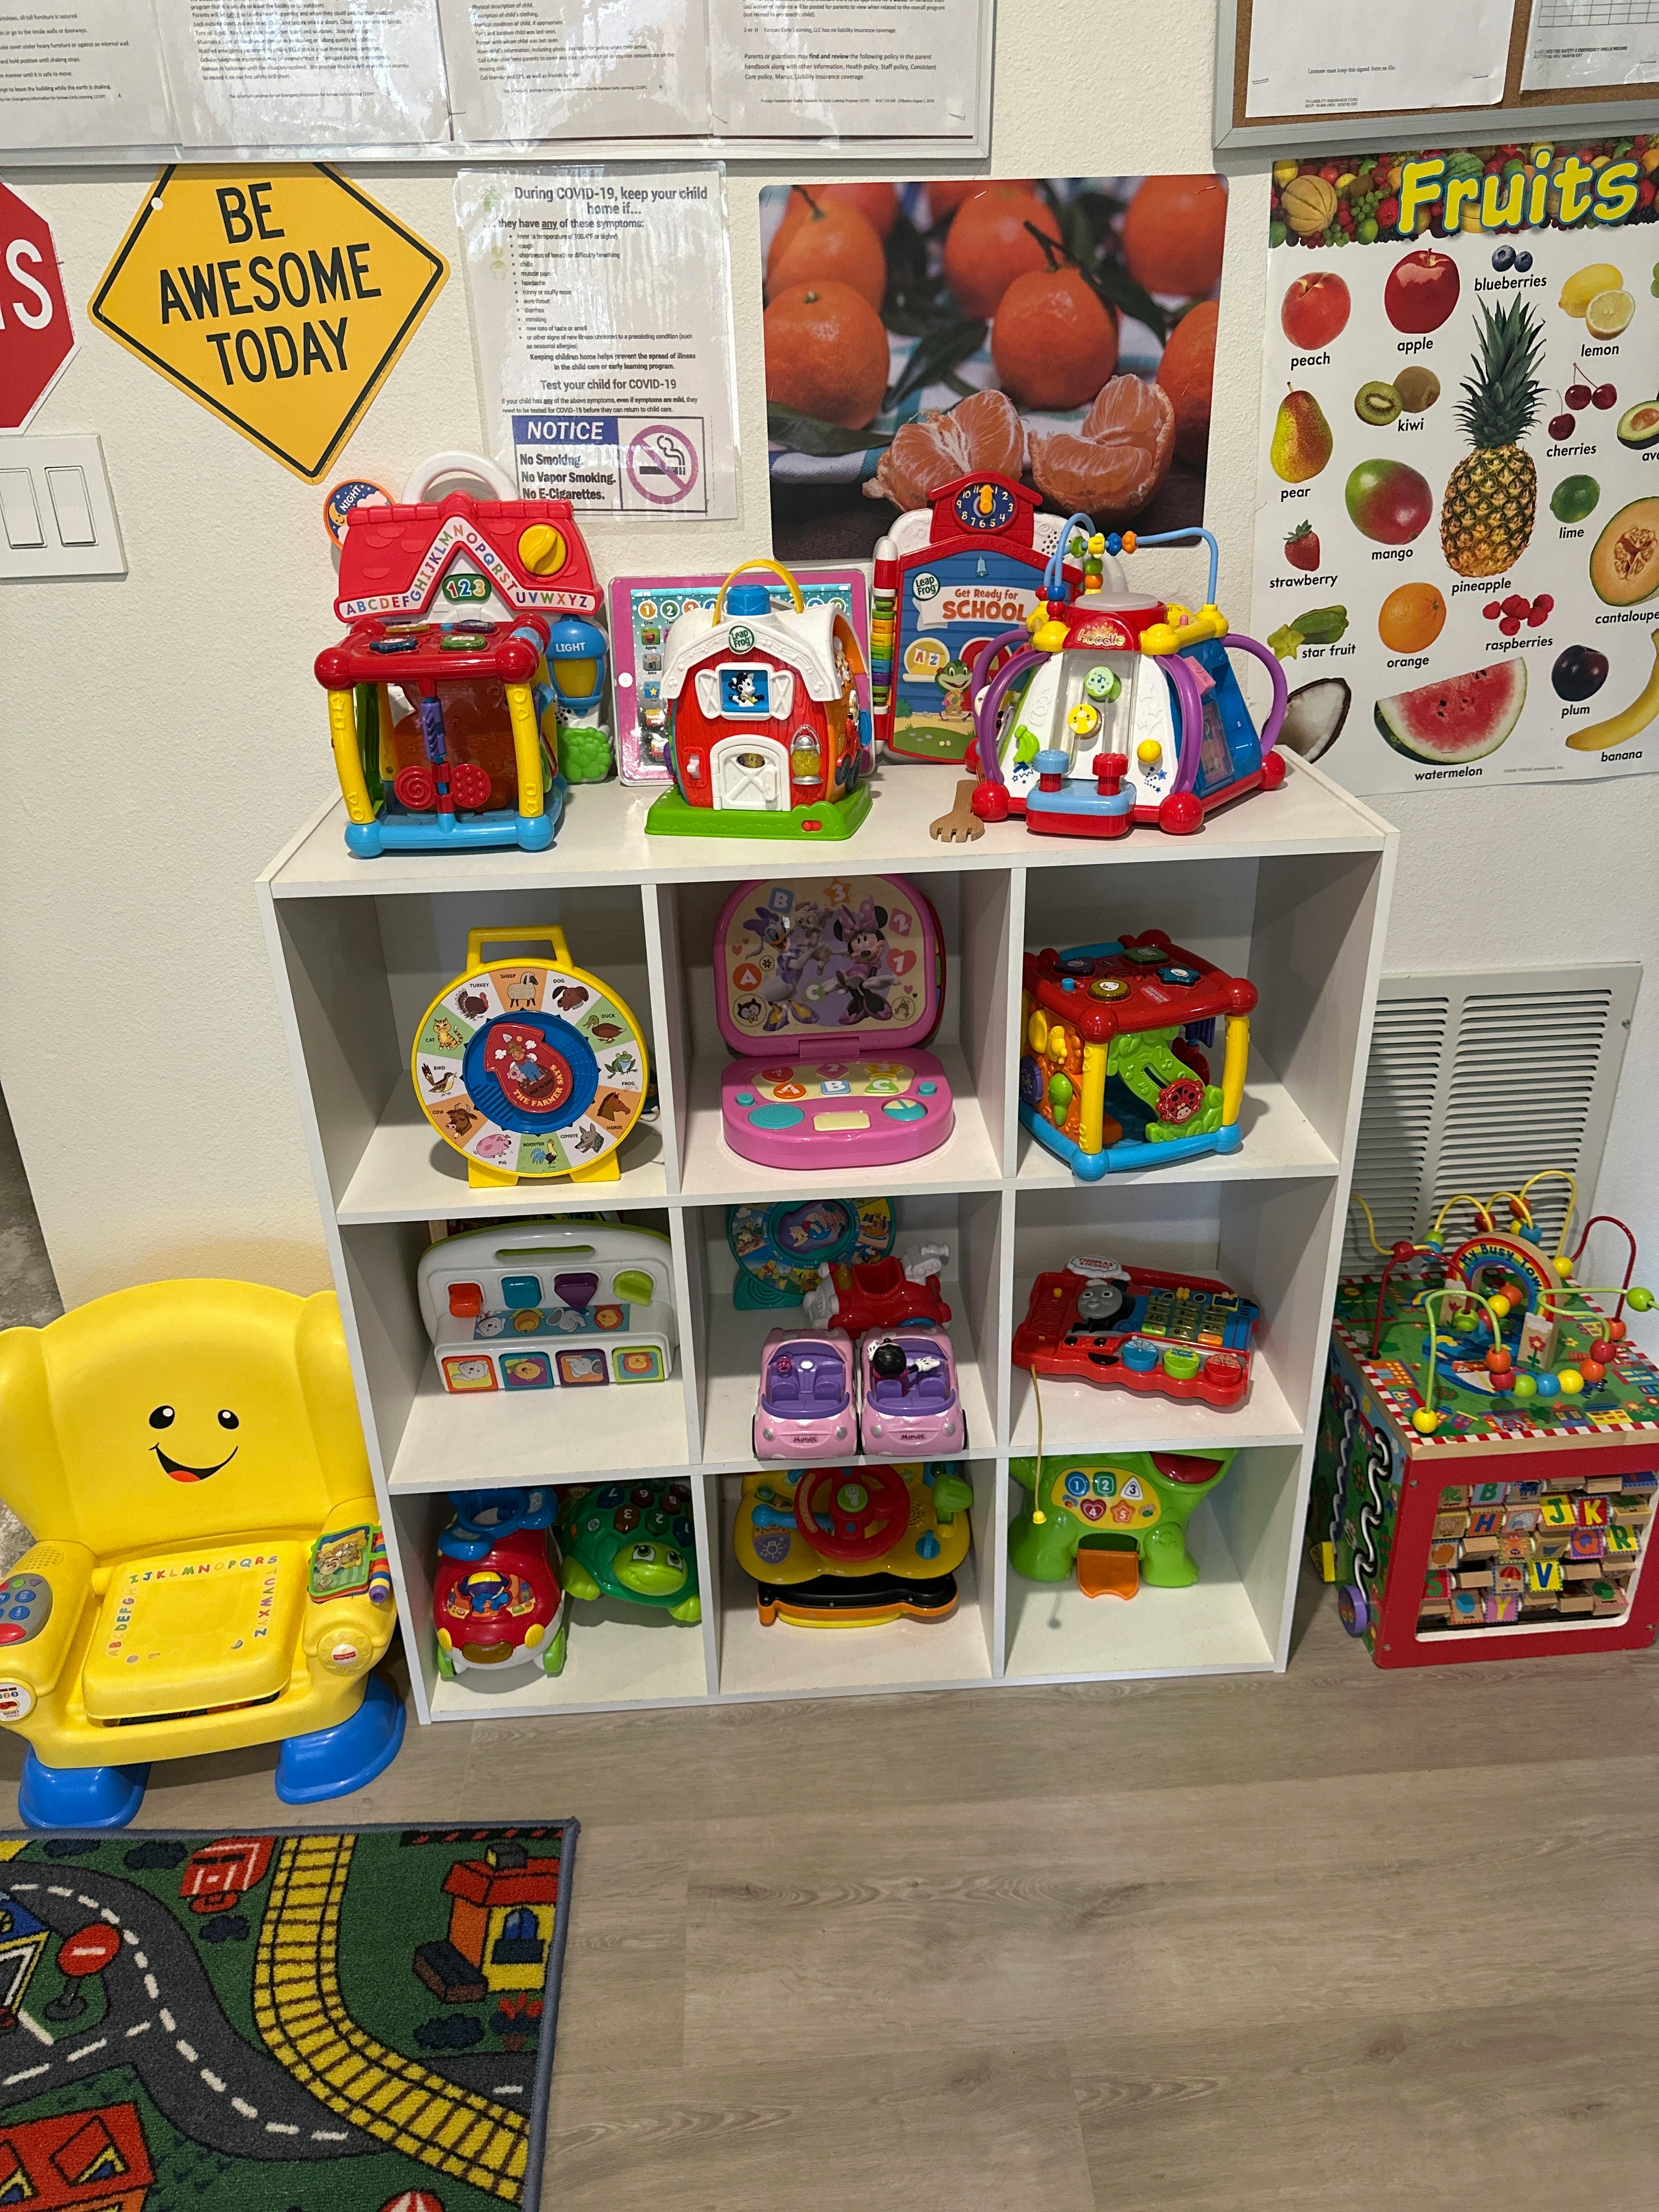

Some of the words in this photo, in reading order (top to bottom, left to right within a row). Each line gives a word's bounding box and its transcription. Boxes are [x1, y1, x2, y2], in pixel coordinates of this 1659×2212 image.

[515, 187, 554, 202] During
[556, 187, 618, 201] COVID-19,
[620, 187, 648, 202] keep
[651, 190, 677, 202] your
[679, 187, 708, 200] child
[1398, 149, 1641, 236] Fruits
[216, 182, 285, 245] BE
[586, 202, 619, 215] home
[622, 202, 641, 215] if...
[498, 219, 517, 229] they
[519, 219, 540, 228] have
[541, 221, 558, 229] any
[559, 218, 569, 228] of
[570, 219, 595, 228] these
[596, 220, 644, 230] symptoms:
[159, 242, 382, 325] AWESOME
[1474, 275, 1547, 292] blueberries
[206, 317, 349, 386] TODAY
[1397, 337, 1434, 355] apple
[1581, 343, 1620, 357] lemon
[1290, 352, 1331, 371] peach
[540, 380, 562, 390] Test
[563, 382, 585, 392] your
[588, 379, 611, 390] child
[612, 379, 627, 389] for
[629, 379, 677, 390] COVID-19
[527, 421, 604, 440] NOTICE
[1397, 417, 1424, 432] kiwi
[1546, 443, 1597, 458] cherries
[520, 454, 534, 465] No
[535, 454, 584, 468] Smoking.
[521, 472, 535, 483] No
[538, 472, 566, 486] Vapor
[568, 471, 617, 485] Smoking.
[522, 488, 537, 499] No
[539, 488, 605, 500] E-Cigarettes.
[962, 490, 971, 499] 10
[973, 486, 979, 494] 11
[995, 486, 998, 494] 1
[1002, 492, 1008, 500] 2
[1280, 487, 1311, 502] pear
[340, 485, 361, 511] NIGHT
[956, 500, 962, 509] 9
[1007, 503, 1014, 512] 3
[961, 511, 968, 520] 8
[970, 517, 976, 526] 7
[990, 518, 996, 527] 5
[1000, 514, 1005, 522] 4
[979, 519, 985, 528] 6
[1559, 526, 1584, 539] lime
[1371, 548, 1414, 562] mango
[916, 577, 934, 588] Leap
[1269, 574, 1338, 589] strawberry
[1451, 578, 1511, 595] pineapple
[917, 585, 936, 596] Frog
[955, 589, 970, 597] Get
[974, 589, 1002, 601] Ready
[1005, 589, 1018, 600] for
[644, 605, 650, 615] 1
[667, 605, 674, 615] 2
[943, 600, 1027, 622] SCHOOL
[1595, 610, 1659, 625] cantaloupe
[732, 631, 749, 641] Leap
[734, 638, 751, 647] Frog
[1077, 629, 1126, 647] Hoodle
[555, 641, 586, 653] LIGHT
[1302, 646, 1325, 659] star
[1329, 644, 1356, 657] fruit
[1485, 636, 1553, 653] raspberries
[1386, 656, 1429, 670] orange
[1561, 704, 1590, 719] plum
[1600, 750, 1643, 763] banana
[1414, 766, 1483, 781] watermelon
[833, 883, 846, 902] 3
[773, 891, 789, 910] B
[894, 915, 909, 932] 2
[893, 955, 905, 973] 1
[739, 969, 758, 986] A
[805, 984, 820, 1000] C
[513, 1088, 530, 1104] THE
[531, 1086, 563, 1107] FARMER
[550, 1064, 564, 1086] SAYS
[1079, 1257, 1113, 1267] THOMAS
[1074, 1481, 1079, 1490] 1
[1103, 1480, 1109, 1490] 2
[1130, 1485, 1136, 1494] 3
[1479, 1483, 1498, 1501] B
[1088, 1508, 1097, 1516] 4
[1119, 1510, 1126, 1519] 5
[1549, 1498, 1563, 1523] J
[1584, 1499, 1603, 1525] K
[1474, 1513, 1496, 1533] H
[1573, 1534, 1598, 1555] Q
[1610, 1525, 1631, 1550] R
[1536, 1562, 1553, 1588] V
[1425, 1571, 1443, 1596] S
[1494, 1596, 1512, 1621] Y
